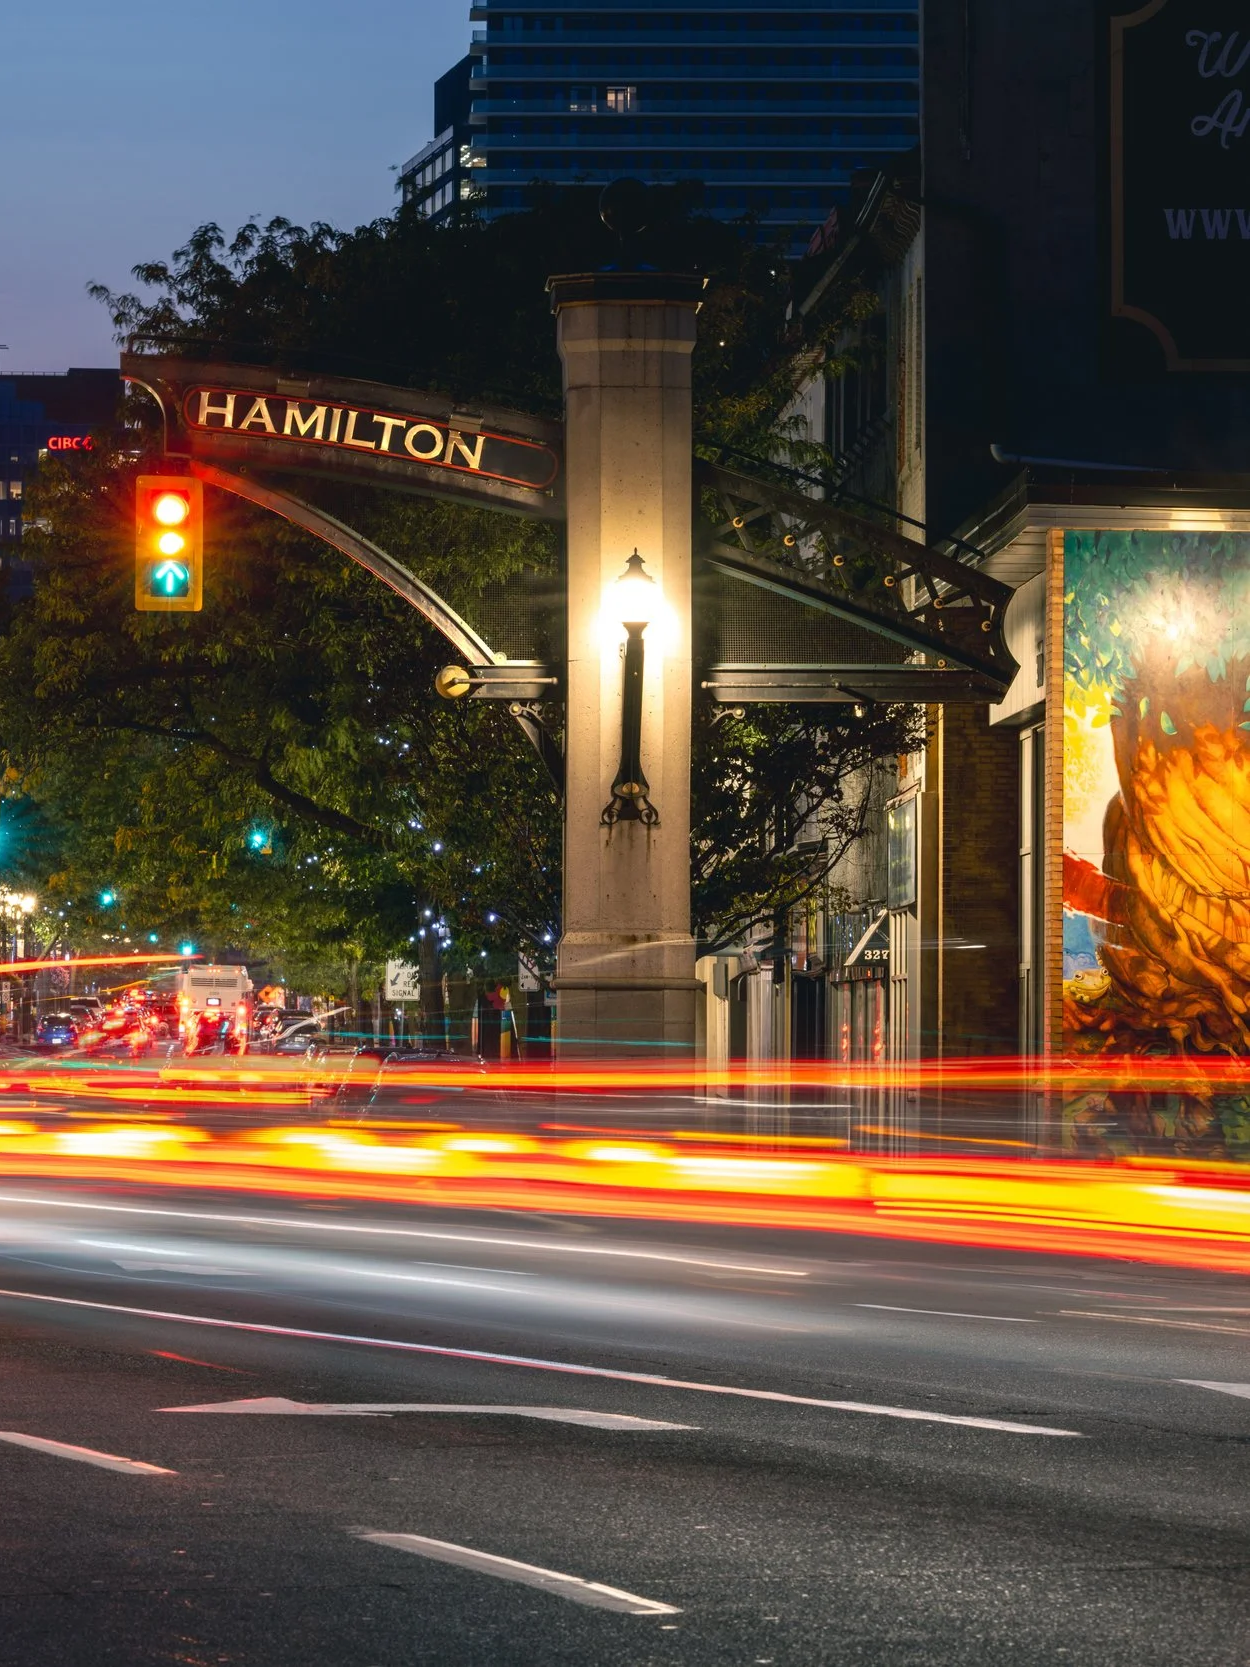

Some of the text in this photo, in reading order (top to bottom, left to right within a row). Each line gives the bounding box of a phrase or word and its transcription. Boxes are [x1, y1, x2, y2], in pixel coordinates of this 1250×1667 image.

[197, 391, 486, 470] HAMILTON
[48, 436, 81, 450] CIBC
[864, 950, 890, 960] 327
[391, 989, 415, 997] SIGNAL
